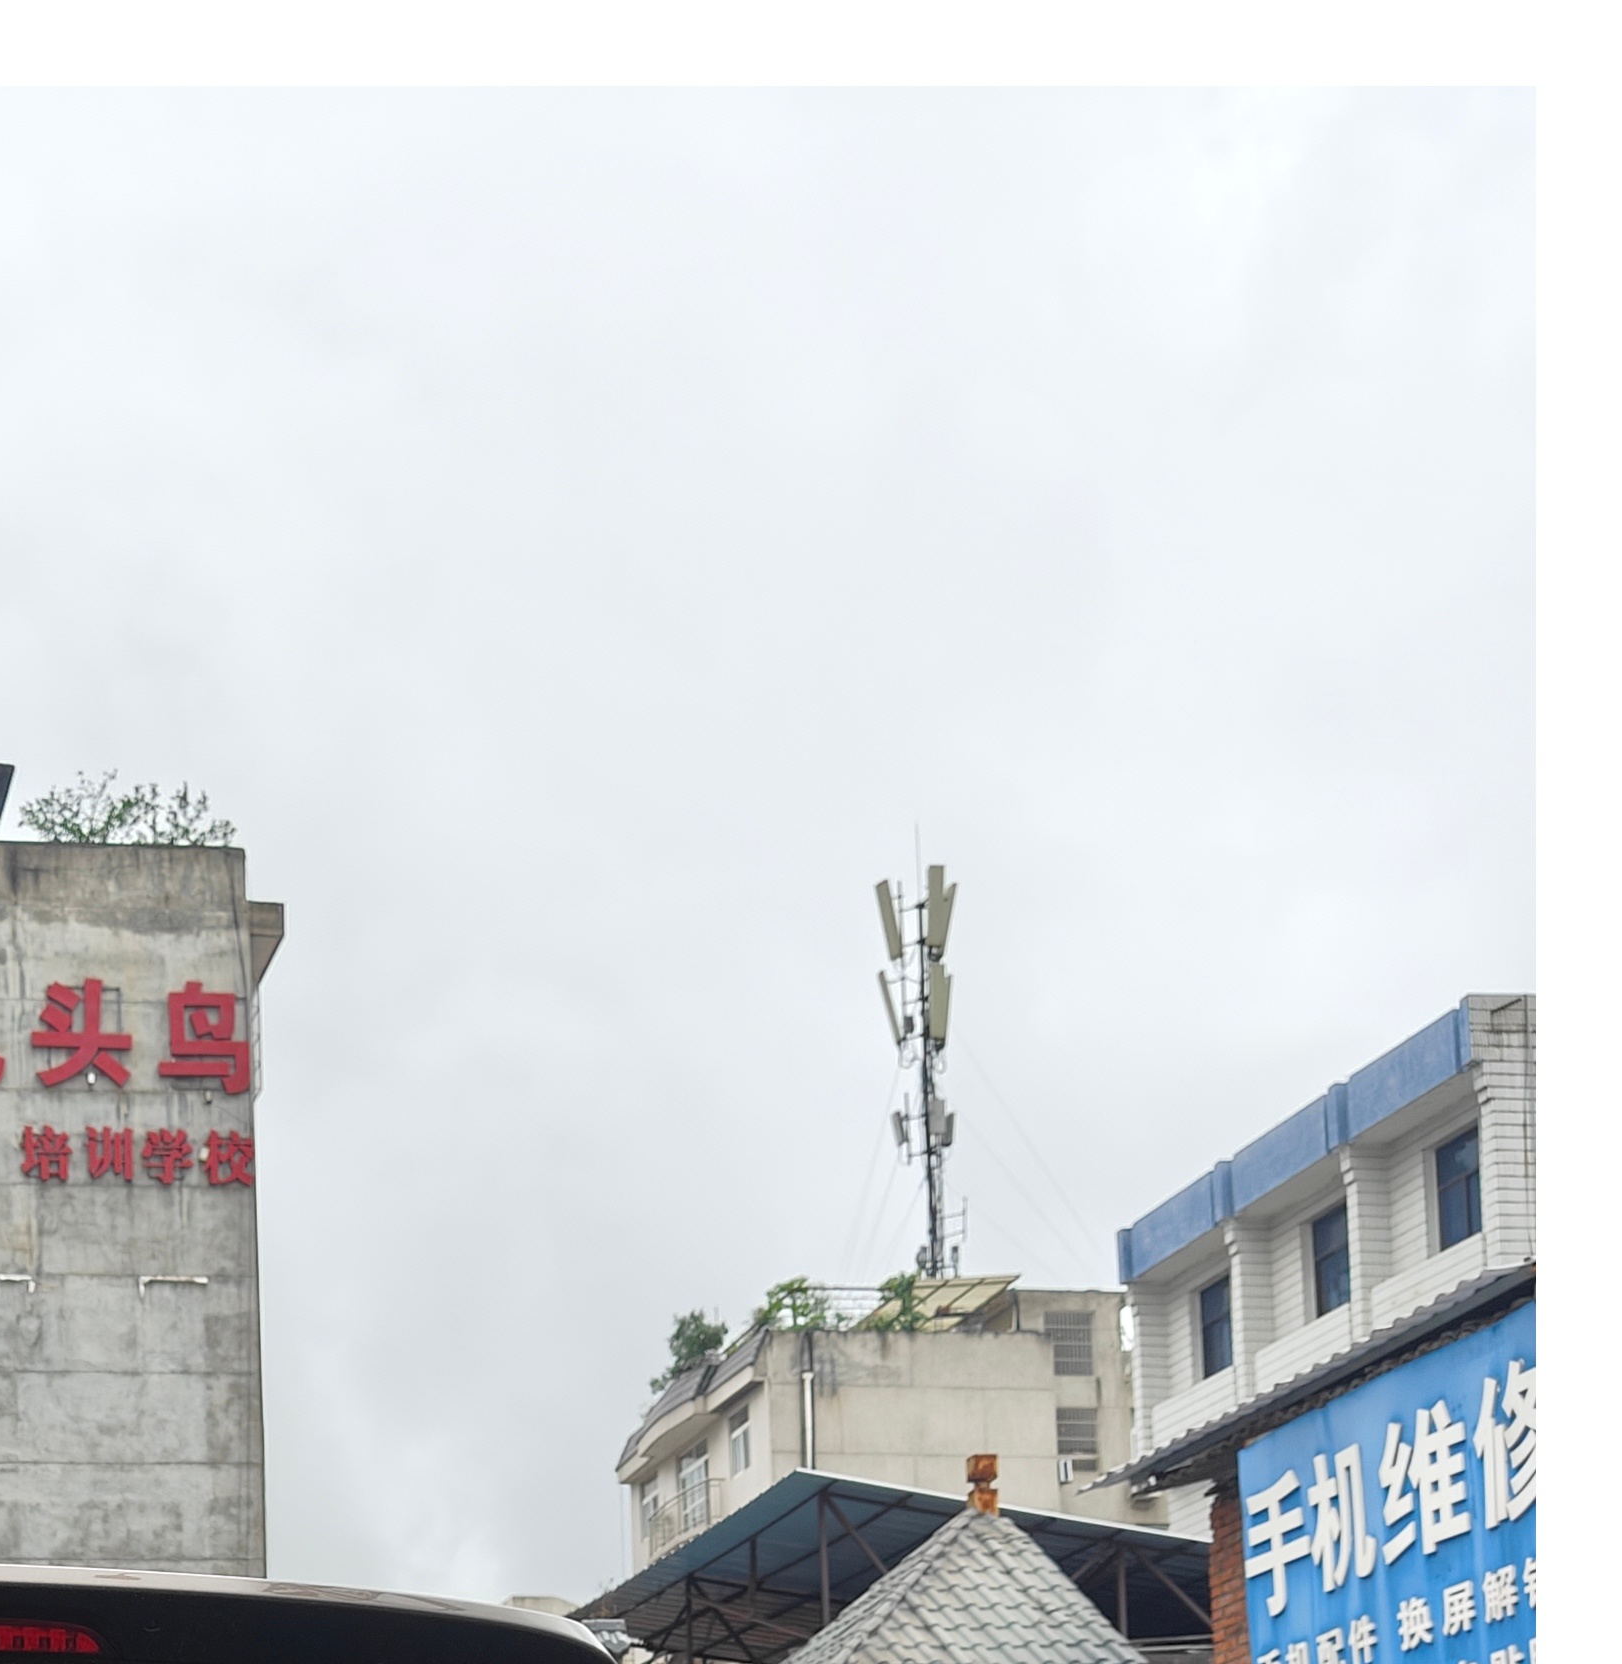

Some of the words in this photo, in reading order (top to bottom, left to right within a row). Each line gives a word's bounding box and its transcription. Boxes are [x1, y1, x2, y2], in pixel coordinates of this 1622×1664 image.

[20, 1125, 255, 1187] 培训学校
[1245, 1359, 1536, 1618] 手机维修
